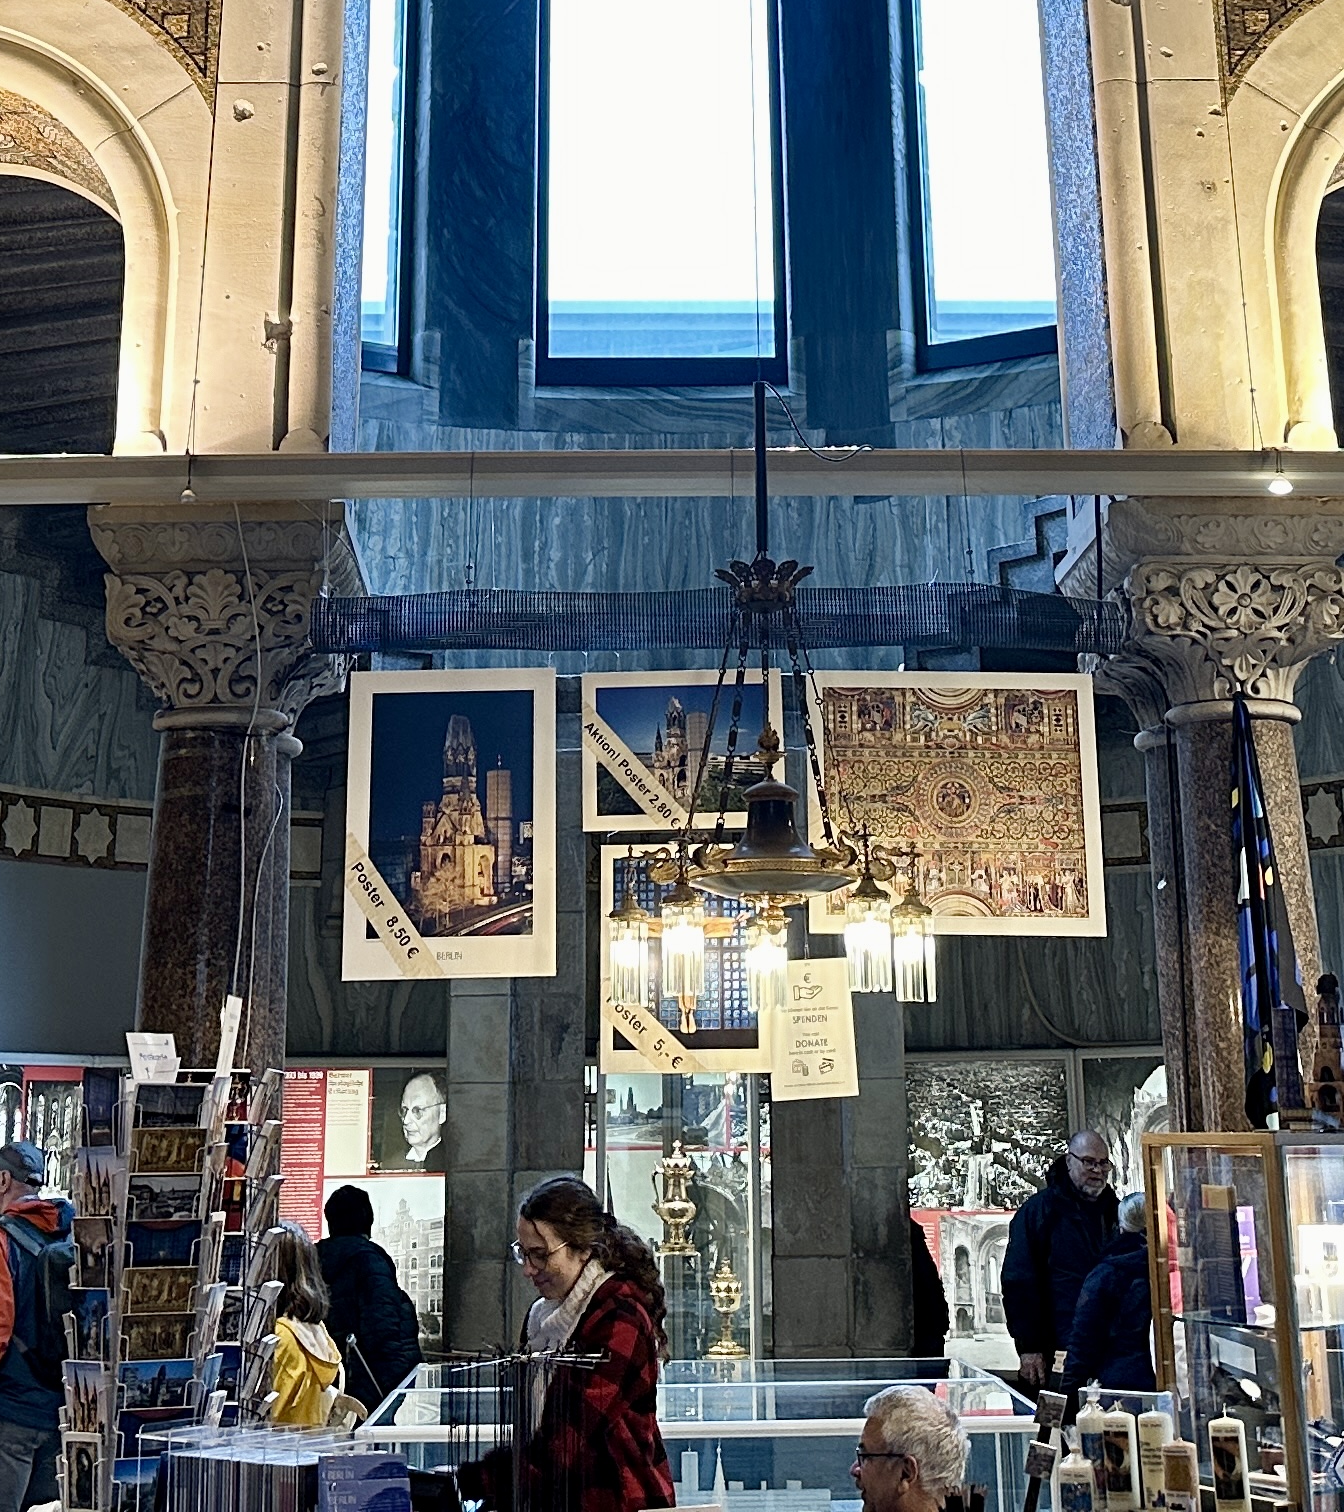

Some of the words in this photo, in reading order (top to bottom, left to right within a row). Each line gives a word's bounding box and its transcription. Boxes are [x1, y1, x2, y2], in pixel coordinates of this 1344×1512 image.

[584, 723, 621, 761] Aktion!
[618, 759, 651, 796] Poster
[649, 794, 672, 818] 2,80
[351, 861, 385, 908] Poster
[386, 916, 411, 947] 8,50
[407, 947, 420, 959] €
[606, 996, 648, 1035] oster
[671, 1056, 684, 1069] €
[792, 1014, 828, 1024] SPENDEN
[795, 1038, 828, 1048] DONATE
